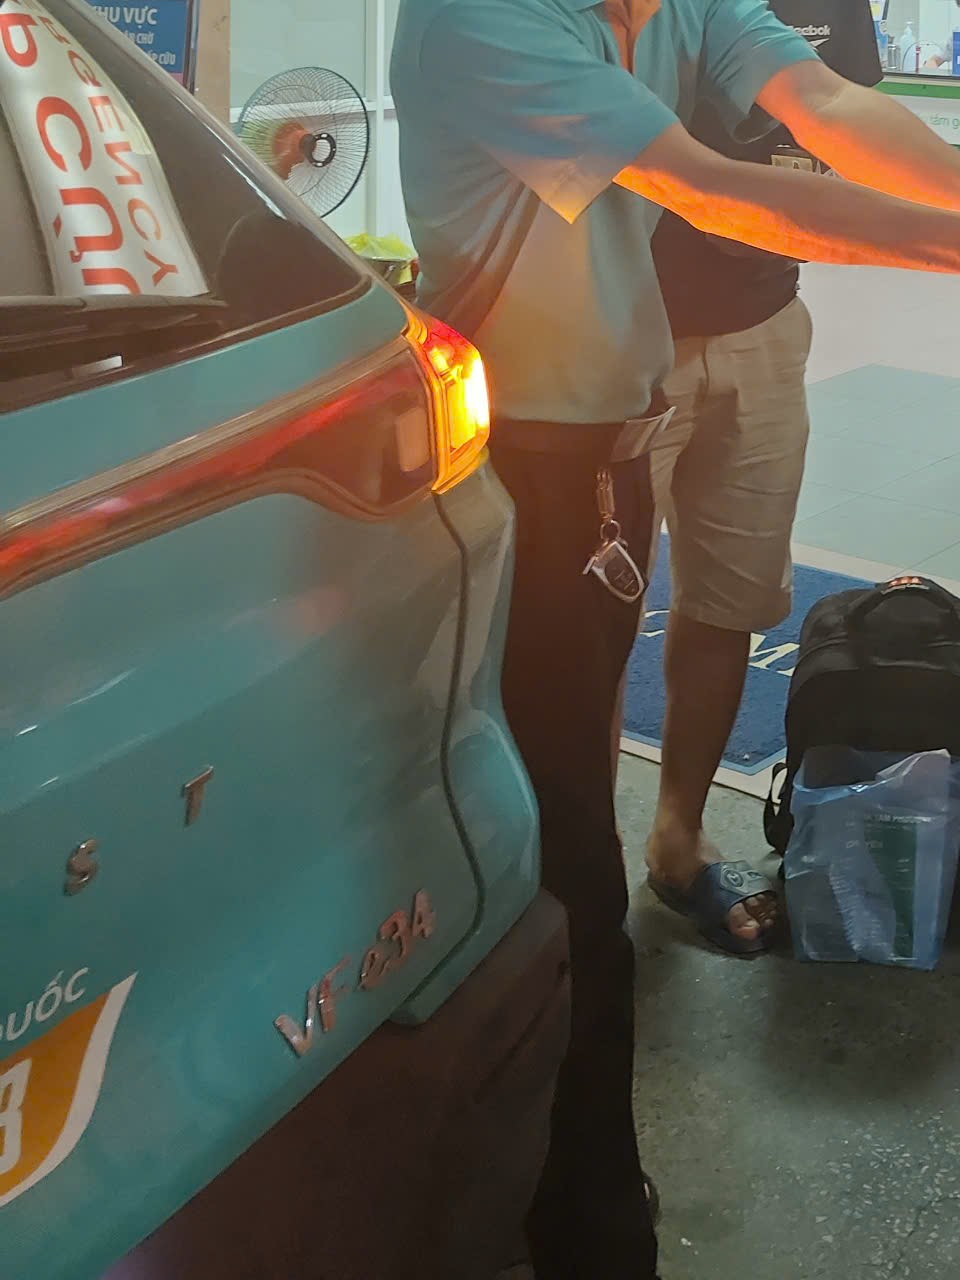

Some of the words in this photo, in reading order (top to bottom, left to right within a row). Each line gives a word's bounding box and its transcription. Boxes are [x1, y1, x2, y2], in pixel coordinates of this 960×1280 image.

[94, 6, 120, 23] HU
[123, 5, 158, 29] VỰC
[786, 24, 831, 36] eebok
[0, 966, 89, 1042] UỐC
